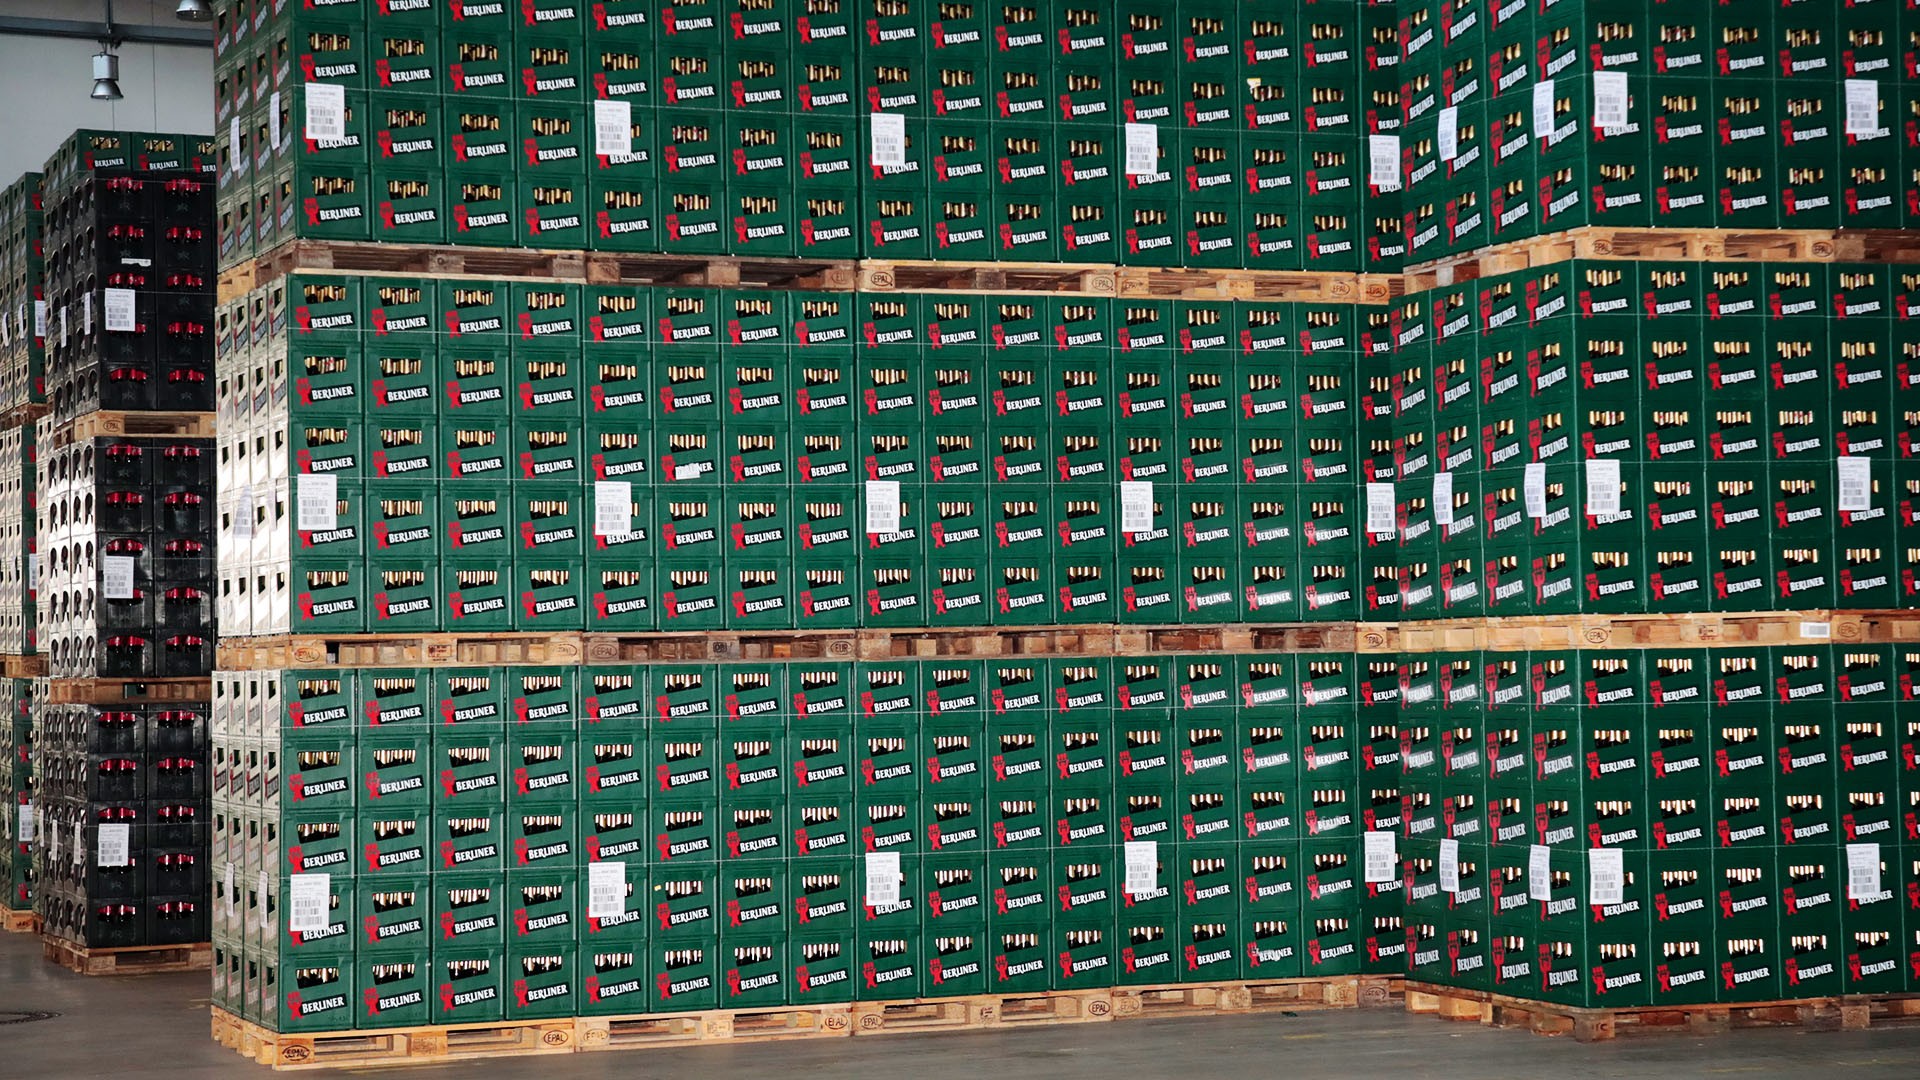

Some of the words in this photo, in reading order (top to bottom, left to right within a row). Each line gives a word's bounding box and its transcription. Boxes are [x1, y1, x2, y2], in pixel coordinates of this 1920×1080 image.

[463, 4, 503, 17] BERLINER
[607, 13, 645, 26] BERLINER
[744, 22, 780, 35] BERLINER
[880, 28, 915, 41] BERLINER
[1134, 42, 1168, 55] BERLINER
[1256, 48, 1288, 61] BERLINER
[391, 69, 431, 82] BERLINER
[537, 78, 575, 91] BERLINER
[677, 86, 714, 100] BERLINER
[946, 98, 981, 111] BERLINER
[1197, 110, 1230, 123] BERLINER
[1317, 114, 1349, 127] BERLINER
[1731, 126, 1765, 141] BERLINER
[392, 140, 433, 153] BERLINER
[538, 148, 577, 161] BERLINER
[94, 158, 124, 167] BERLINER
[149, 161, 178, 170] BERLINER
[747, 157, 783, 171] BERLINER
[947, 164, 982, 177] BERLINER
[1259, 176, 1291, 189] BERLINER
[1606, 194, 1641, 208] BERLINER
[1732, 196, 1767, 210] BERLINER
[395, 211, 435, 224] BERLINER
[540, 217, 579, 231] BERLINER
[680, 223, 717, 236] BERLINER
[814, 227, 850, 241] BERLINER
[1076, 232, 1110, 246] BERLINER
[1200, 238, 1232, 251] BERLINER
[1319, 242, 1351, 255] BERLINER
[873, 275, 888, 284] EPAL
[1095, 279, 1109, 288] EPAL
[1592, 299, 1627, 313] BERLINER
[1719, 300, 1754, 315] BERLINER
[1846, 302, 1880, 316] BERLINER
[311, 315, 353, 330] BERLINER
[1489, 306, 1517, 329] BERLINER
[531, 321, 572, 337] BERLINER
[673, 326, 711, 340] BERLINER
[809, 329, 845, 343] BERLINER
[1399, 324, 1424, 346] BERLINER
[1068, 332, 1102, 346] BERLINER
[1312, 338, 1344, 351] BERLINER
[1537, 367, 1567, 390] BERLINER
[1658, 370, 1693, 385] BERLINER
[1783, 370, 1818, 384] BERLINER
[388, 388, 428, 402] BERLINER
[534, 390, 573, 405] BERLINER
[1444, 382, 1470, 404] BERLINER
[674, 394, 712, 408] BERLINER
[810, 396, 847, 410] BERLINER
[1068, 398, 1102, 412] BERLINER
[1193, 400, 1226, 414] BERLINER
[1313, 401, 1345, 415] BERLINER
[1595, 440, 1630, 454] BERLINER
[1723, 439, 1757, 454] BERLINER
[1848, 439, 1883, 453] BERLINER
[1492, 443, 1519, 465] BERLINER
[312, 457, 353, 472] BERLINER
[462, 459, 502, 473] BERLINER
[605, 462, 644, 476] BERLINER
[811, 463, 847, 478] BERLINER
[1070, 463, 1104, 477] BERLINER
[1314, 464, 1347, 478] BERLINER
[1403, 455, 1428, 476] BERLINER
[1724, 509, 1759, 524] BERLINER
[462, 529, 502, 544] BERLINER
[676, 530, 714, 545] BERLINER
[1008, 528, 1043, 543] BERLINER
[1196, 529, 1229, 543] BERLINER
[1542, 578, 1572, 599] BERLINER
[1599, 580, 1634, 596] BERLINER
[1727, 579, 1762, 594] BERLINER
[1852, 576, 1887, 591] BERLINER
[536, 598, 575, 613] BERLINER
[677, 599, 715, 614] BERLINER
[814, 597, 850, 612] BERLINER
[1072, 593, 1107, 607] BERLINER
[1196, 592, 1232, 607] BERLINER
[313, 600, 355, 615] BERLINER
[1590, 632, 1604, 641] EPAL
[597, 647, 612, 656] EPAL
[1598, 688, 1633, 703] BERLINER
[1727, 686, 1762, 701] BERLINER
[1851, 682, 1885, 696] BERLINER
[807, 699, 844, 714] BERLINER
[940, 696, 975, 711] BERLINER
[1068, 693, 1103, 708] BERLINER
[380, 707, 421, 723] BERLINER
[529, 704, 568, 719] BERLINER
[1069, 759, 1104, 774] BERLINER
[1496, 754, 1524, 773] BERLINER
[1664, 758, 1700, 773] BERLINER
[1792, 753, 1826, 769] BERLINER
[940, 763, 976, 778] BERLINER
[380, 778, 422, 794] BERLINER
[529, 774, 568, 789] BERLINER
[671, 771, 709, 786] BERLINER
[1133, 822, 1167, 837] BERLINER
[1256, 817, 1290, 835] BERLINER
[1376, 816, 1400, 828] BERLIN
[1410, 817, 1435, 834] BERLINER
[1855, 820, 1890, 836] BERLINER
[875, 832, 911, 848] BERLINER
[1006, 827, 1041, 843] BERLINER
[1498, 824, 1526, 841] BERLINER
[1602, 830, 1637, 845] BERLINER
[1730, 826, 1765, 842] BERLINER
[600, 842, 639, 858] BERLINER
[740, 837, 777, 853] BERLINER
[304, 852, 345, 868] BERLINER
[1196, 885, 1230, 900] BERLINER
[1007, 894, 1042, 909] BERLINER
[1732, 897, 1767, 913] BERLINER
[671, 908, 709, 925] BERLINER
[809, 902, 846, 918] BERLINER
[455, 917, 495, 934] BERLINER
[1321, 944, 1353, 960] BERLINER
[1135, 953, 1169, 969] BERLINER
[1861, 960, 1896, 976] BERLINER
[876, 967, 912, 983] BERLINER
[1502, 963, 1530, 979] BERLINER
[1734, 968, 1769, 984] BERLINER
[741, 974, 778, 991] BERLINER
[1606, 973, 1641, 989] BERLINER
[455, 988, 495, 1005] BERLINER
[600, 981, 639, 998] BERLINER
[302, 997, 344, 1014] BERLINER
[1092, 1004, 1107, 1012] EPAL
[864, 1018, 879, 1026] EPAL
[548, 1033, 564, 1042] EPAL
